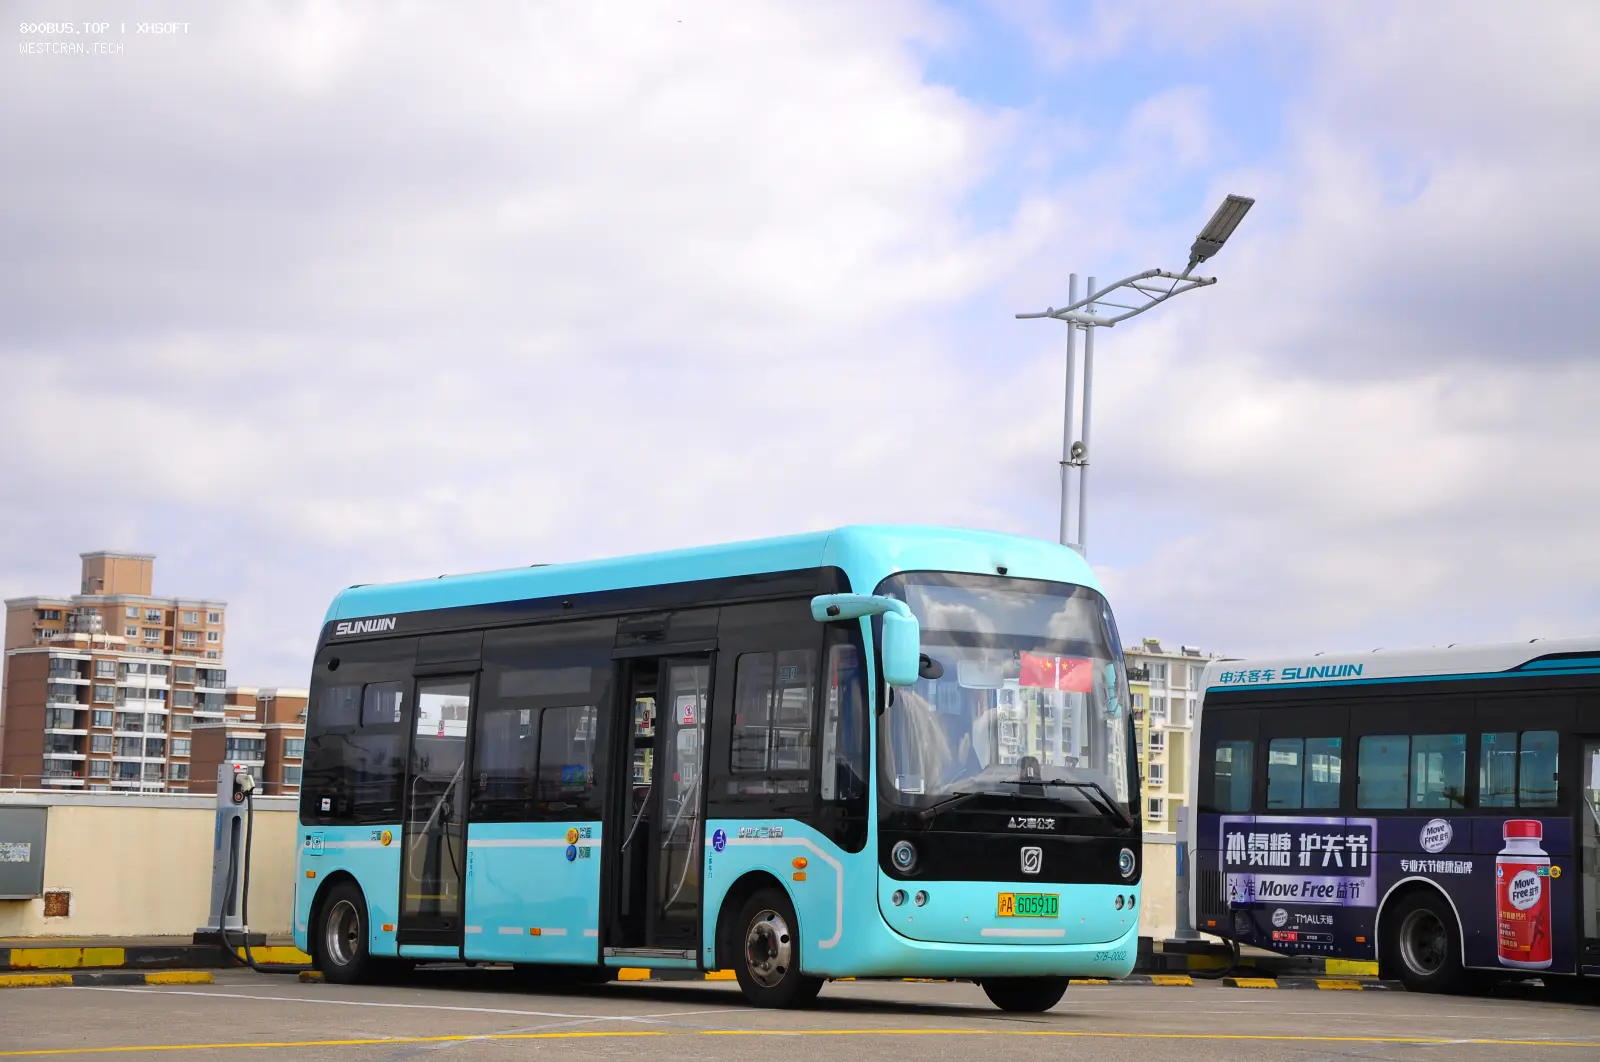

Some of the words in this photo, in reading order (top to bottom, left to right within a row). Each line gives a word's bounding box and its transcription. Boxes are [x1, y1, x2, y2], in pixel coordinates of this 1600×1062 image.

[336, 617, 396, 635] SUNWIN
[1220, 669, 1276, 684] 申沃客车
[1281, 664, 1363, 680] SUNWIN
[1426, 824, 1445, 836] Move
[1424, 833, 1439, 846] Free
[1226, 832, 1291, 866] 补氨糖
[1299, 833, 1368, 867] 护关节
[1400, 859, 1473, 875] 专业关节健康品牌
[1259, 880, 1298, 897] Move
[1301, 881, 1334, 897] Free
[1514, 877, 1535, 890] Move
[1512, 888, 1529, 901] Free
